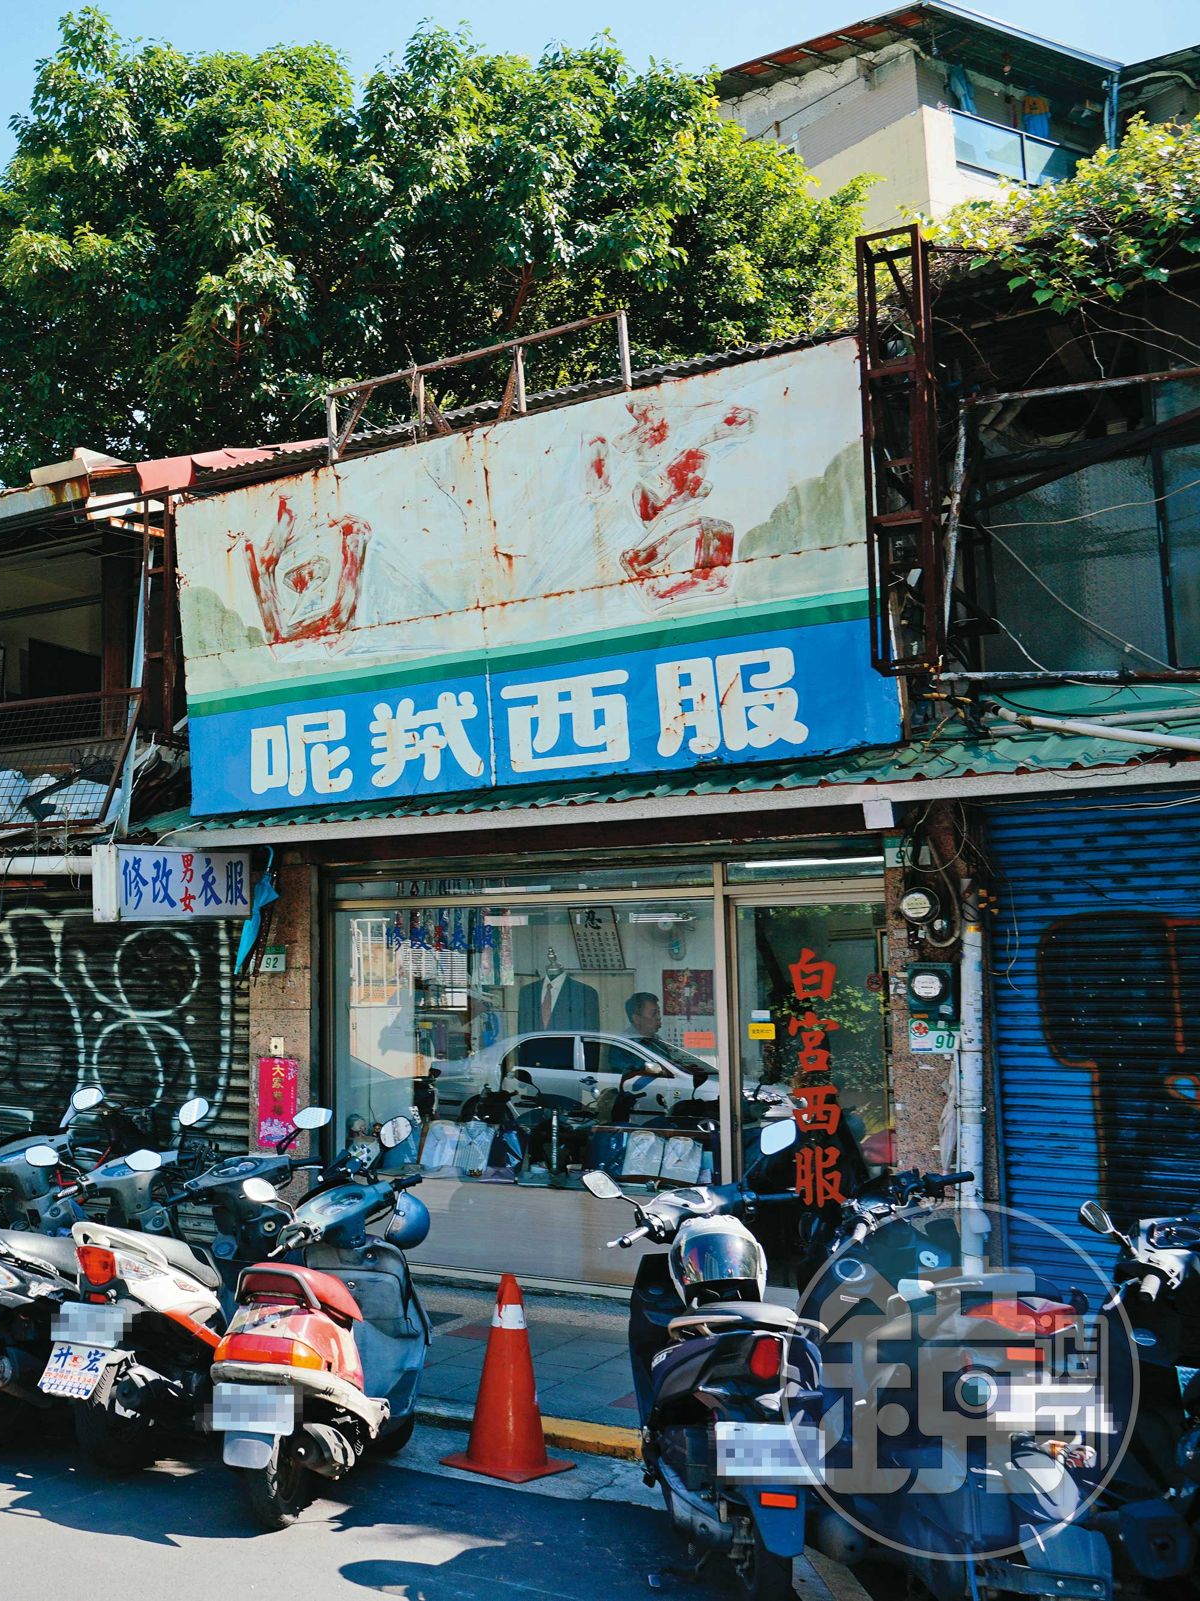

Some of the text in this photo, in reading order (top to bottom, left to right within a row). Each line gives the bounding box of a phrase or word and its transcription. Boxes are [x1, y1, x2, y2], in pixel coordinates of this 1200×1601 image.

[122, 853, 249, 912] 修改男女衣服
[265, 957, 279, 969] 92
[935, 1034, 955, 1049] 90
[787, 947, 850, 1208] 白宮西服
